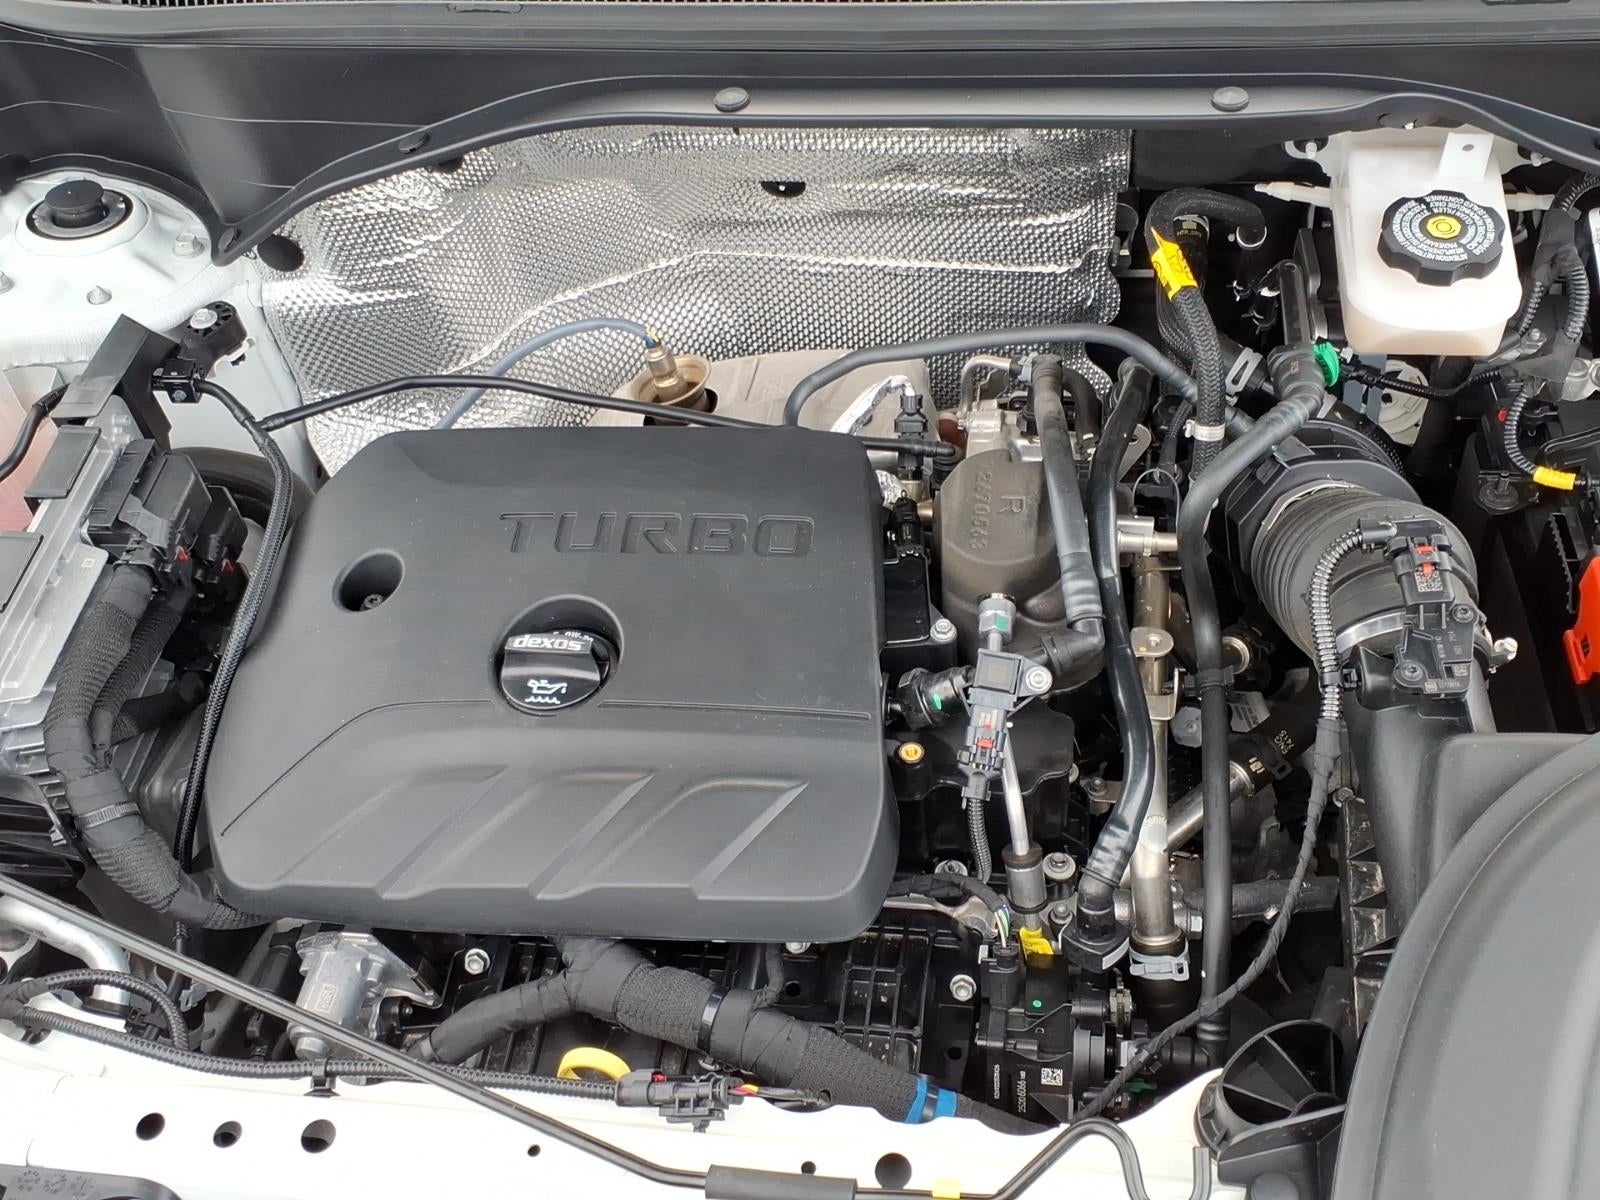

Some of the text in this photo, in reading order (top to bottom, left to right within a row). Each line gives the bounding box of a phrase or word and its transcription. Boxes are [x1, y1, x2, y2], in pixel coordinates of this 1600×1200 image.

[998, 495, 1026, 514] R
[499, 511, 816, 556] TURBO
[512, 634, 586, 651] dexos
